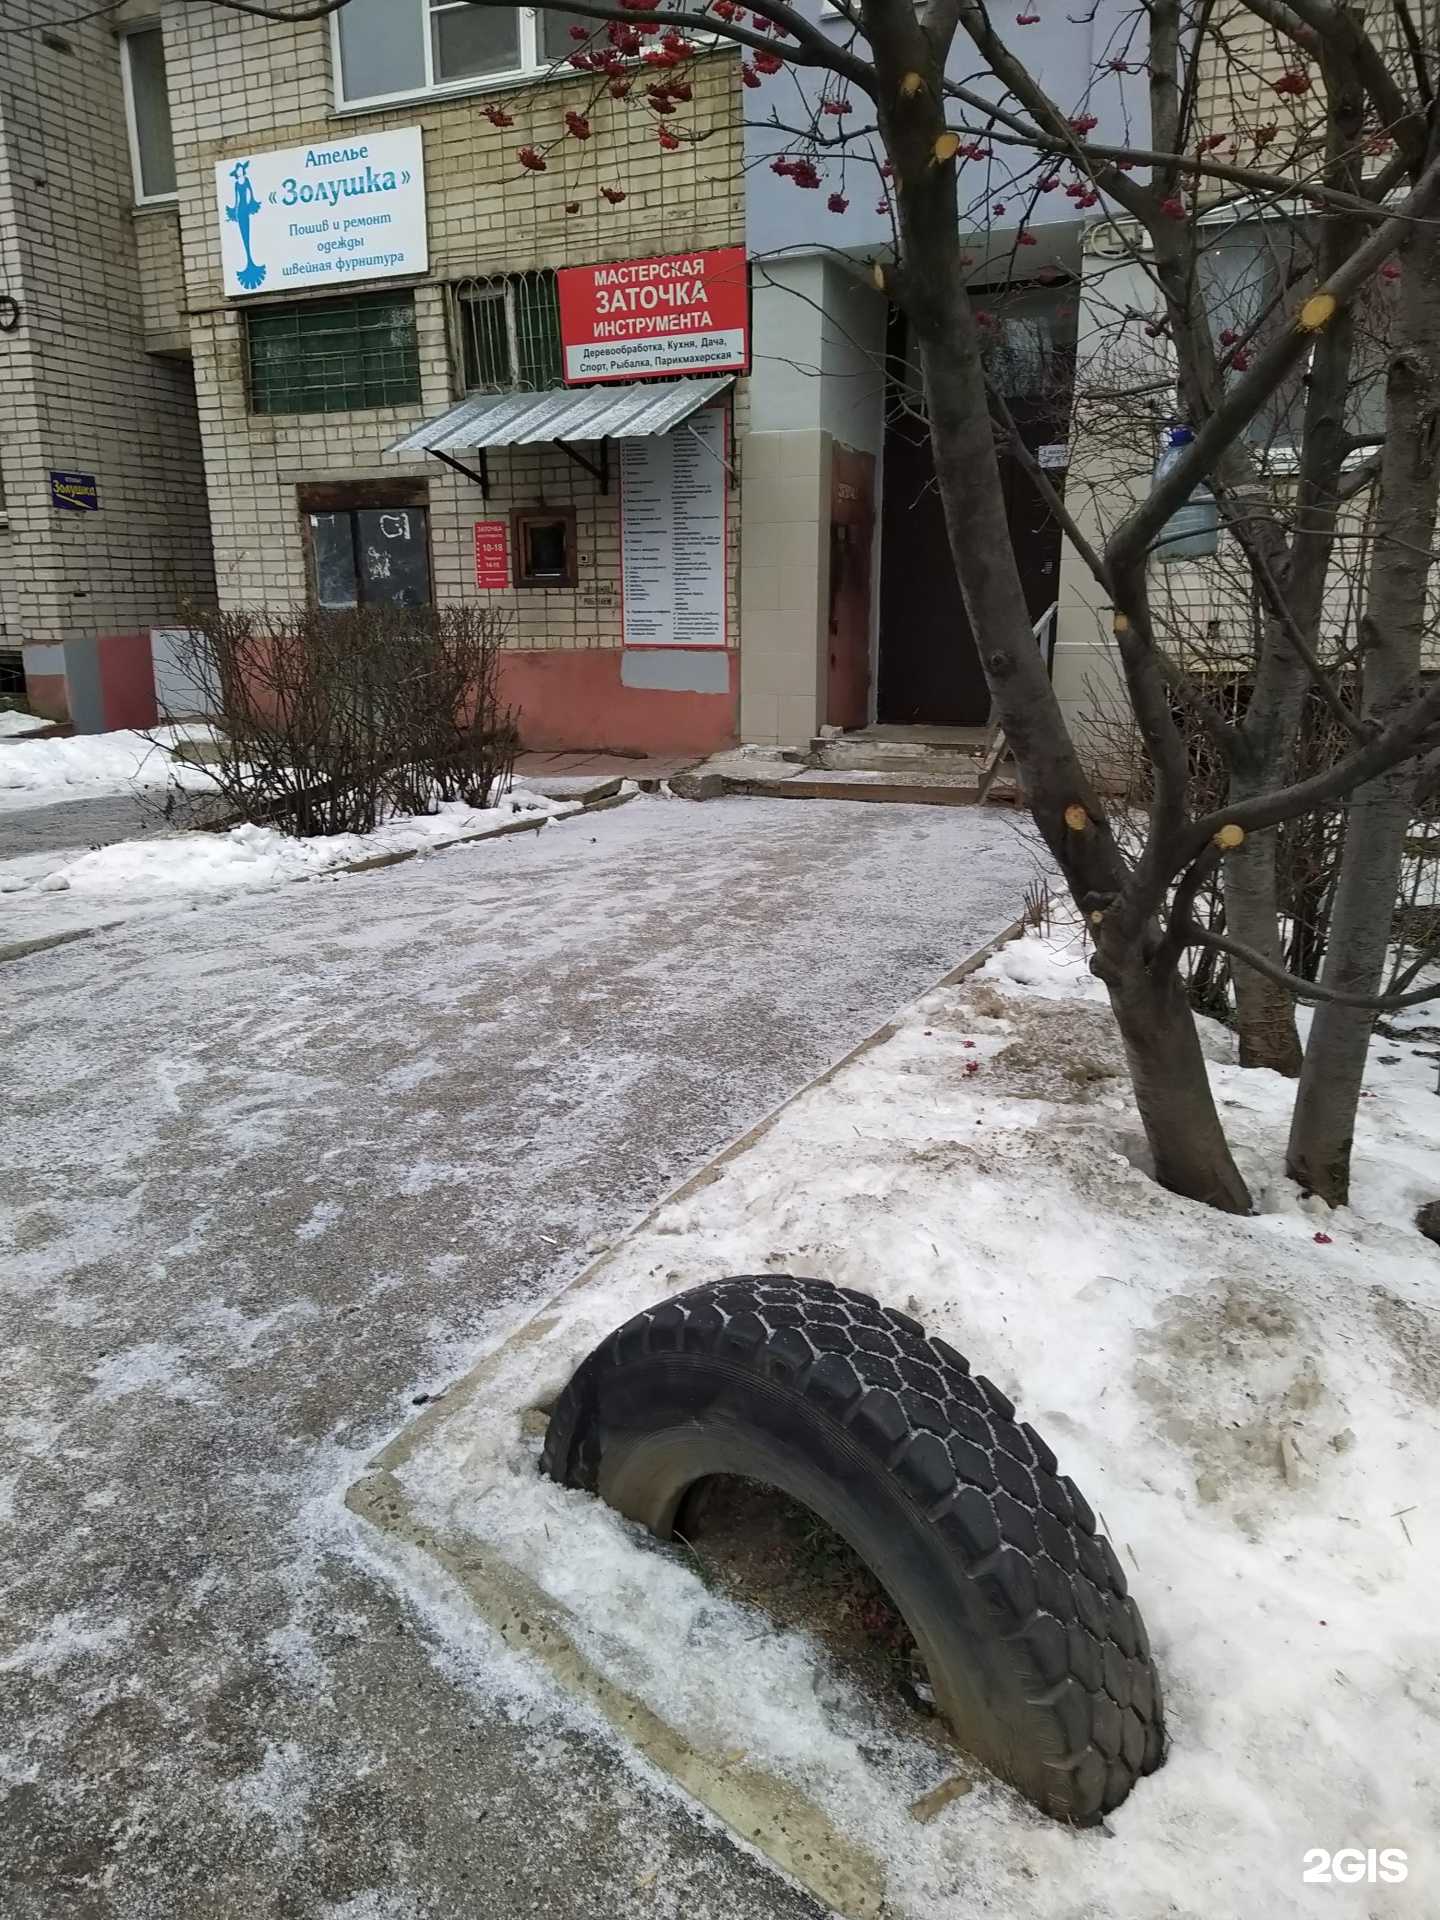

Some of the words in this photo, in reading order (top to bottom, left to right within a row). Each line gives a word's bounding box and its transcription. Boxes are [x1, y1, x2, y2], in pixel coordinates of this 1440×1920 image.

[305, 146, 369, 168] Ателье
[268, 166, 412, 207] «Золушка»
[289, 219, 330, 237] Пошив
[333, 220, 340, 230] и
[343, 213, 392, 232] ремонт
[316, 237, 365, 254] одежды
[281, 258, 332, 277] швейная
[335, 251, 405, 274] фурнитура
[594, 258, 705, 287] МАСТЕРСКАЯ
[595, 280, 709, 315] ЗАТОЧКА
[593, 311, 713, 338] ИНСТРУМЕНТА
[583, 341, 666, 360] Деревообработка,
[667, 338, 698, 352] Кухня,
[701, 335, 728, 349] Дача,
[579, 359, 610, 375] Спорт,
[610, 356, 652, 371] Рыбалка,
[654, 350, 732, 367] Парикмахерская
